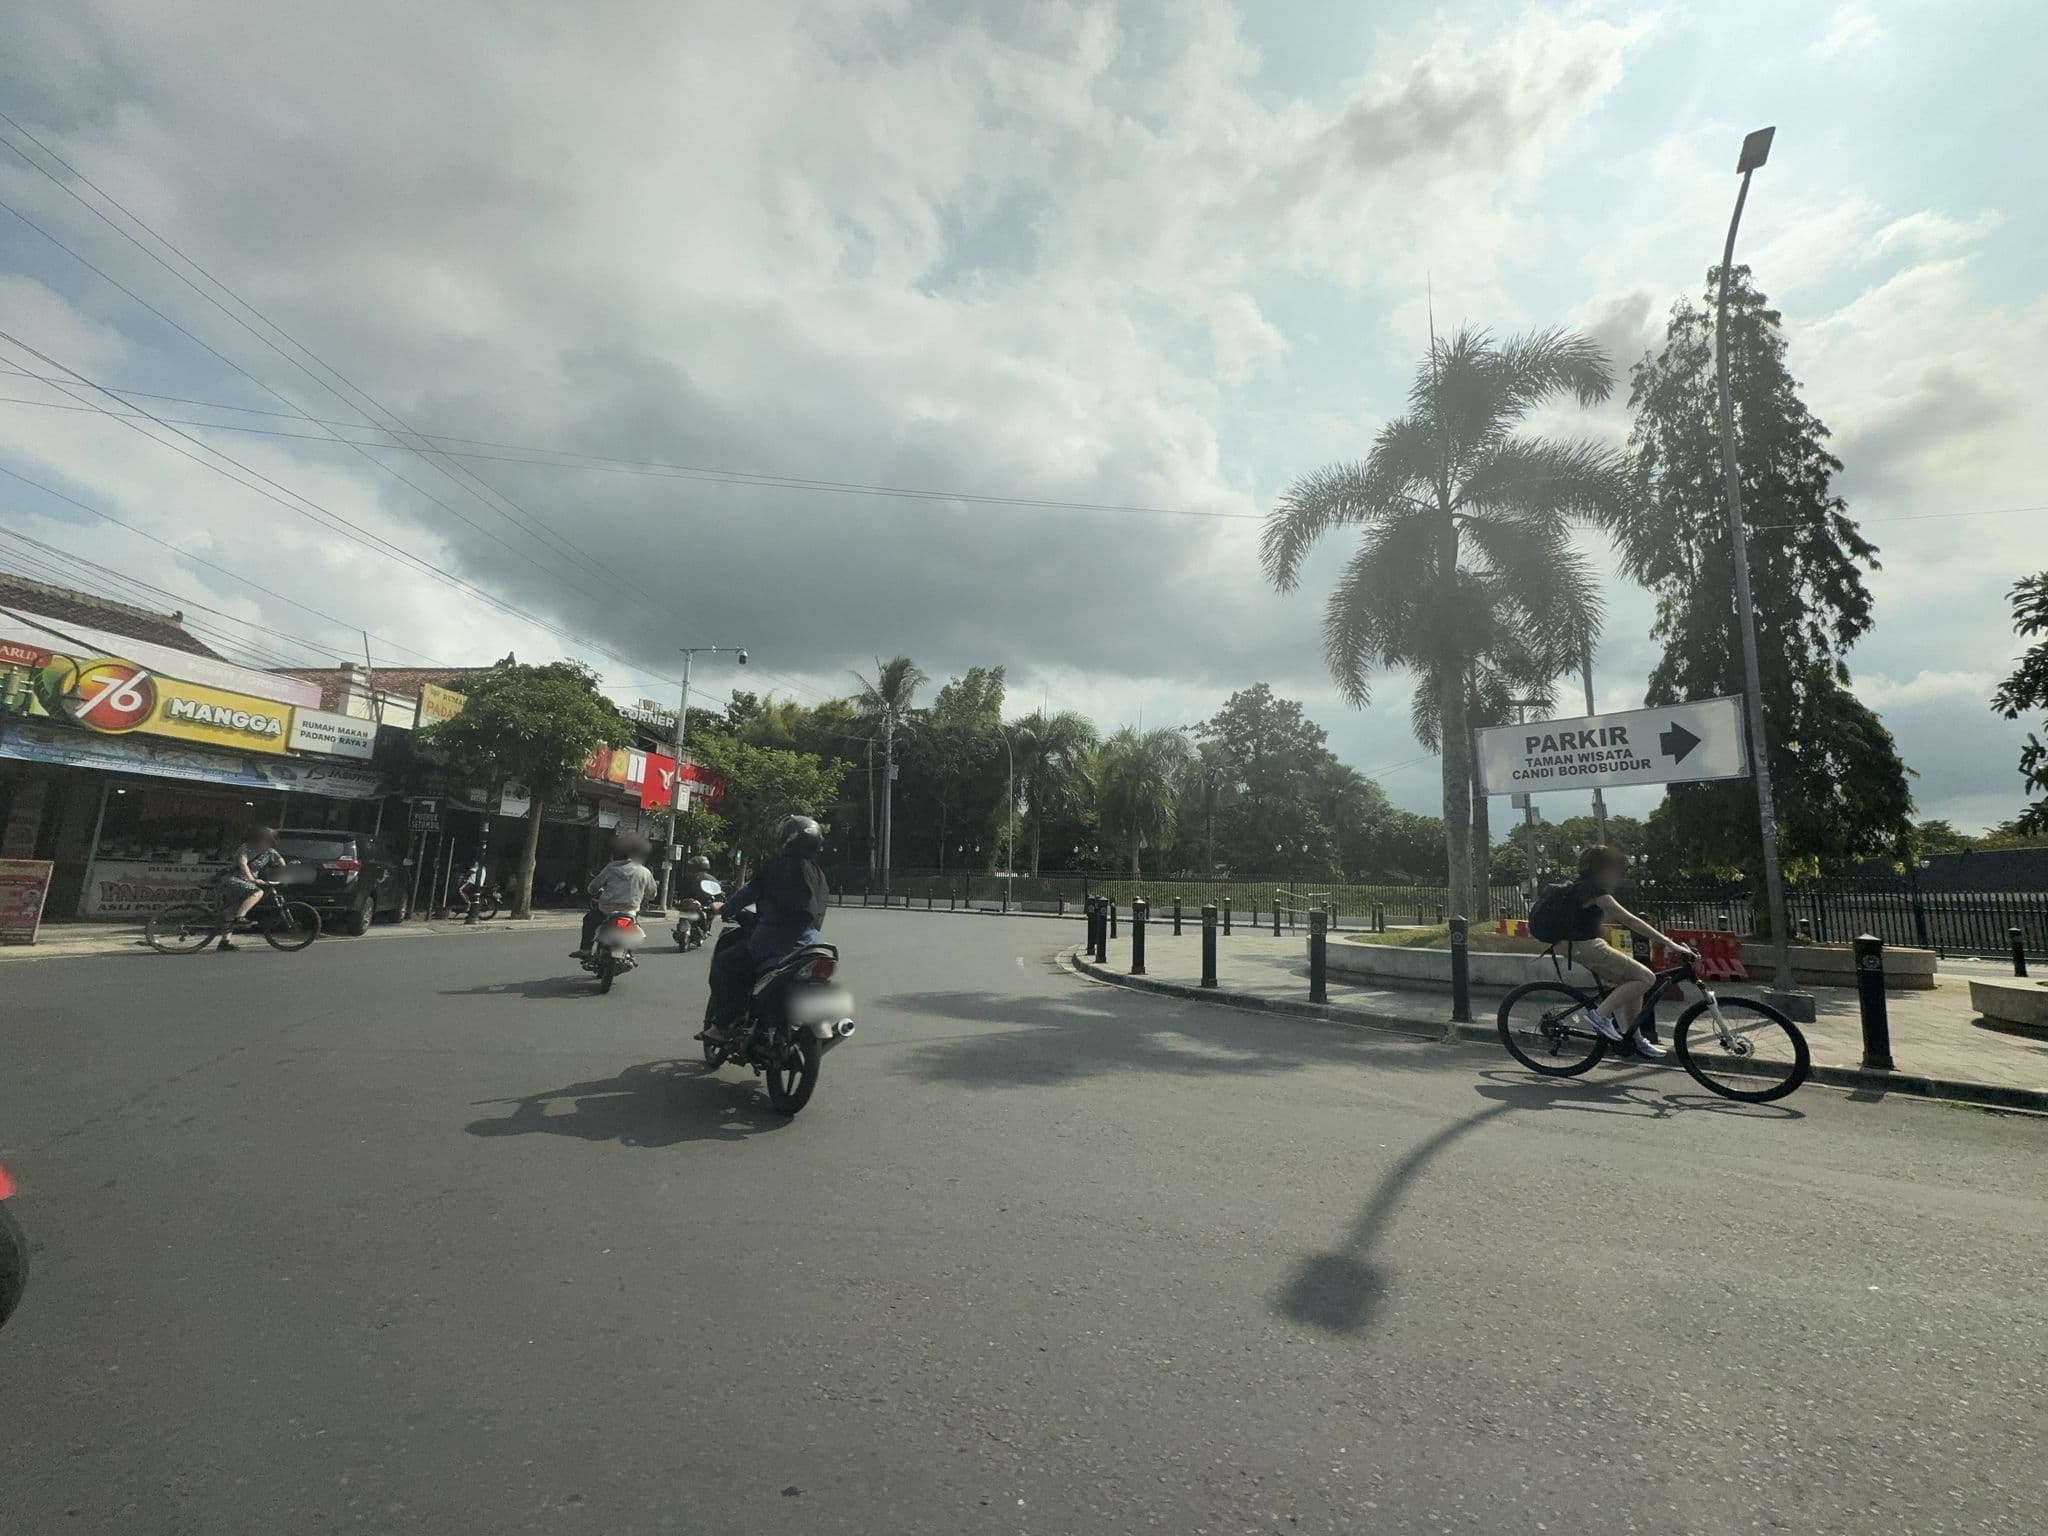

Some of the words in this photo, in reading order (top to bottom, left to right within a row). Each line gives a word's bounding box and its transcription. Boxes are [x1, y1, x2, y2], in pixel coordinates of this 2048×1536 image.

[76, 670, 148, 718] 76
[170, 697, 282, 736] MANGGA
[618, 708, 675, 728] CORNER
[300, 730, 336, 743] PADANG
[338, 736, 361, 748] RAYA
[302, 720, 335, 733] RUMAH
[337, 727, 368, 739] MAKAN
[1525, 726, 1629, 755] PARKIR
[1525, 754, 1574, 768] TAMAN
[1576, 748, 1634, 762] WISATA
[1512, 768, 1554, 780] CANDI
[1558, 759, 1652, 777] BOROBUDUR
